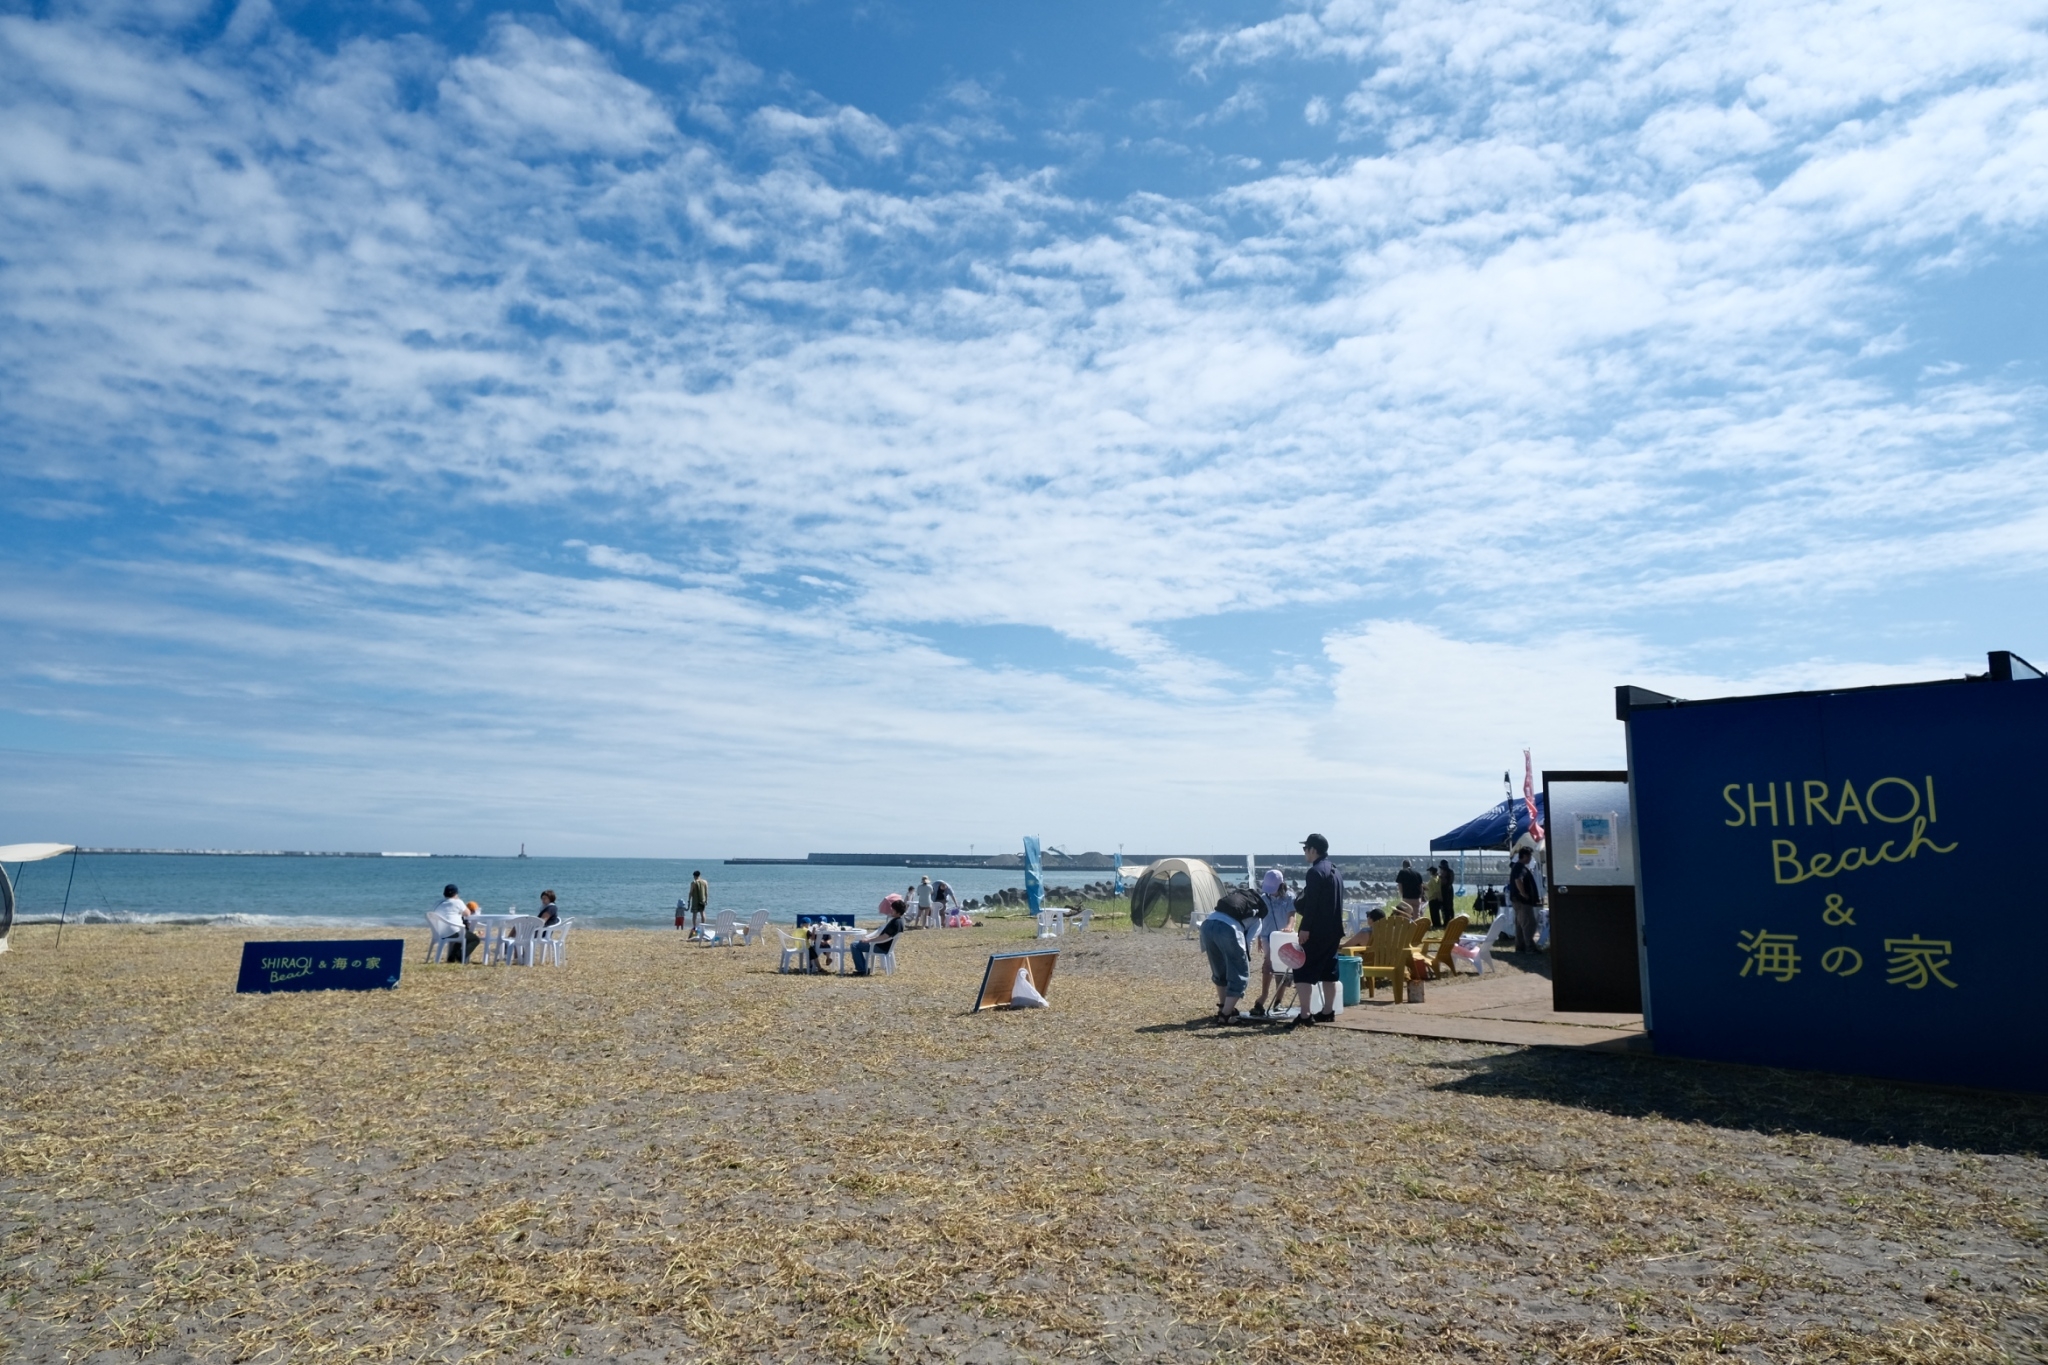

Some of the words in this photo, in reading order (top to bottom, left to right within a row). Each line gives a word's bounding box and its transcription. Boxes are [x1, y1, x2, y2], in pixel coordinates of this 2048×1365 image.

[1723, 775, 1937, 827] SHIRAOI
[1772, 815, 1959, 885] Beach
[1822, 893, 1857, 926] &
[261, 957, 313, 969] SHIRAOI
[318, 960, 327, 969] &
[332, 957, 381, 970] 海の家
[269, 966, 314, 983] Beach
[1737, 929, 1959, 990] 海の家
